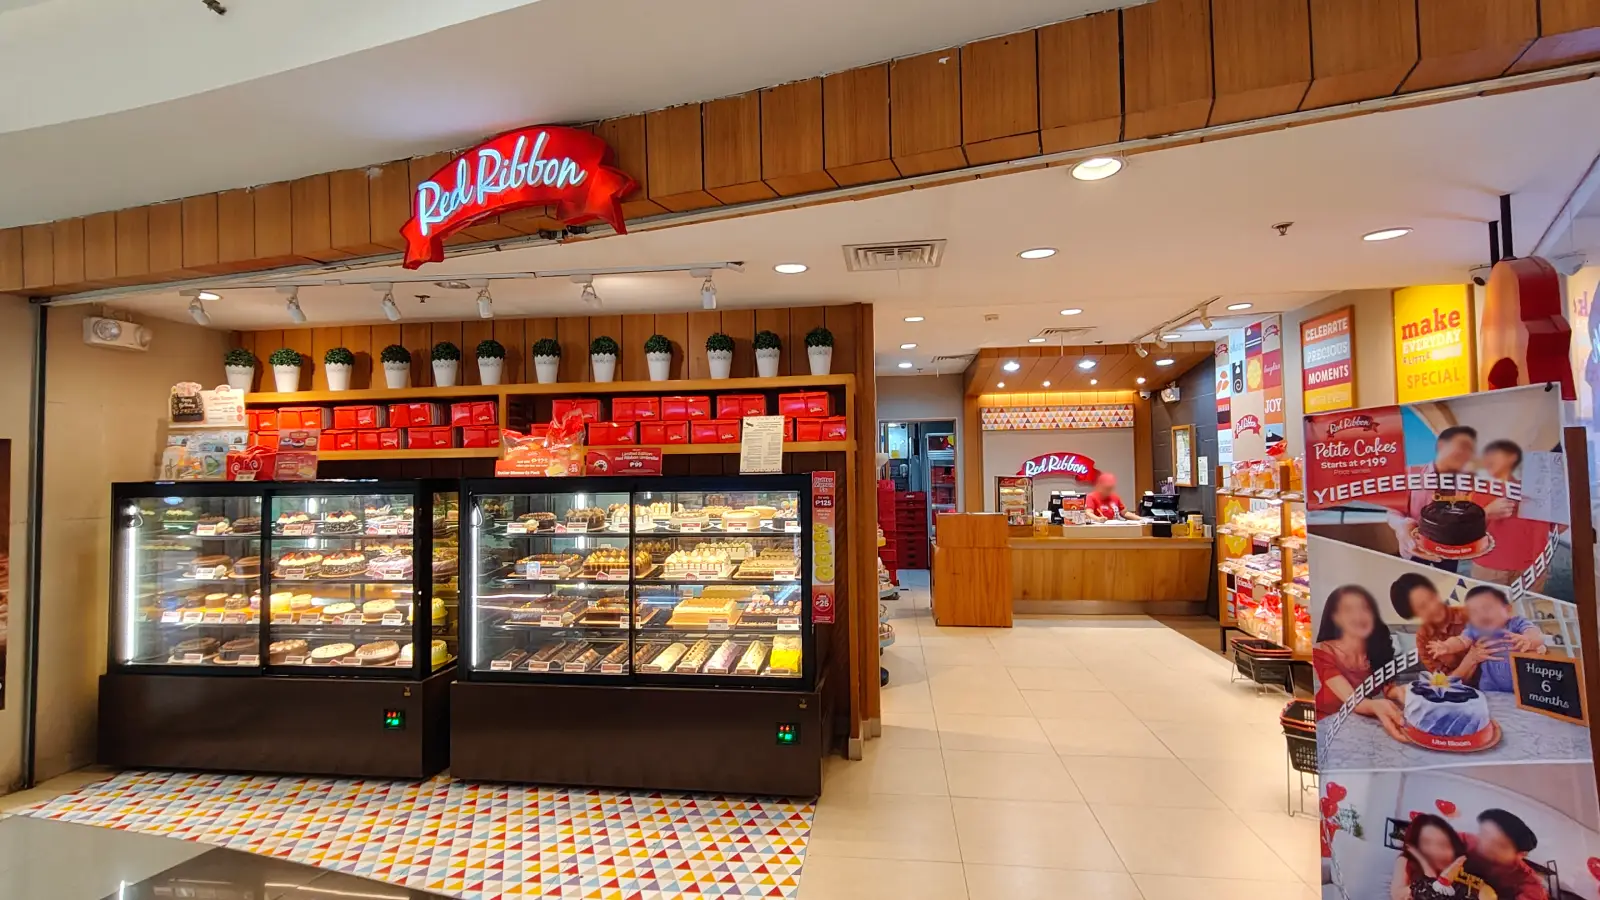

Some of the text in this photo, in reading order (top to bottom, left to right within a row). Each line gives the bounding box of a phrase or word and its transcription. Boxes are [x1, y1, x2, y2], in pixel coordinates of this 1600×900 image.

[417, 130, 588, 237] Red Ribbon
[1305, 317, 1349, 342] CELEBRATE
[1401, 307, 1461, 341] make
[1307, 341, 1348, 364] PRECIOUS
[1402, 328, 1462, 355] EVERYDAY
[1308, 364, 1350, 386] MOMENTS
[1406, 366, 1460, 390] SPECIAL
[1264, 397, 1282, 414] JOY
[1329, 415, 1370, 434] Red Ribbon
[1312, 436, 1398, 460] Petite Cakes
[1024, 455, 1089, 478] Red Ribbon
[1321, 461, 1348, 469] Starts
[1525, 661, 1565, 681] Happy
[1540, 679, 1552, 694] 6
[1528, 692, 1570, 710] months
